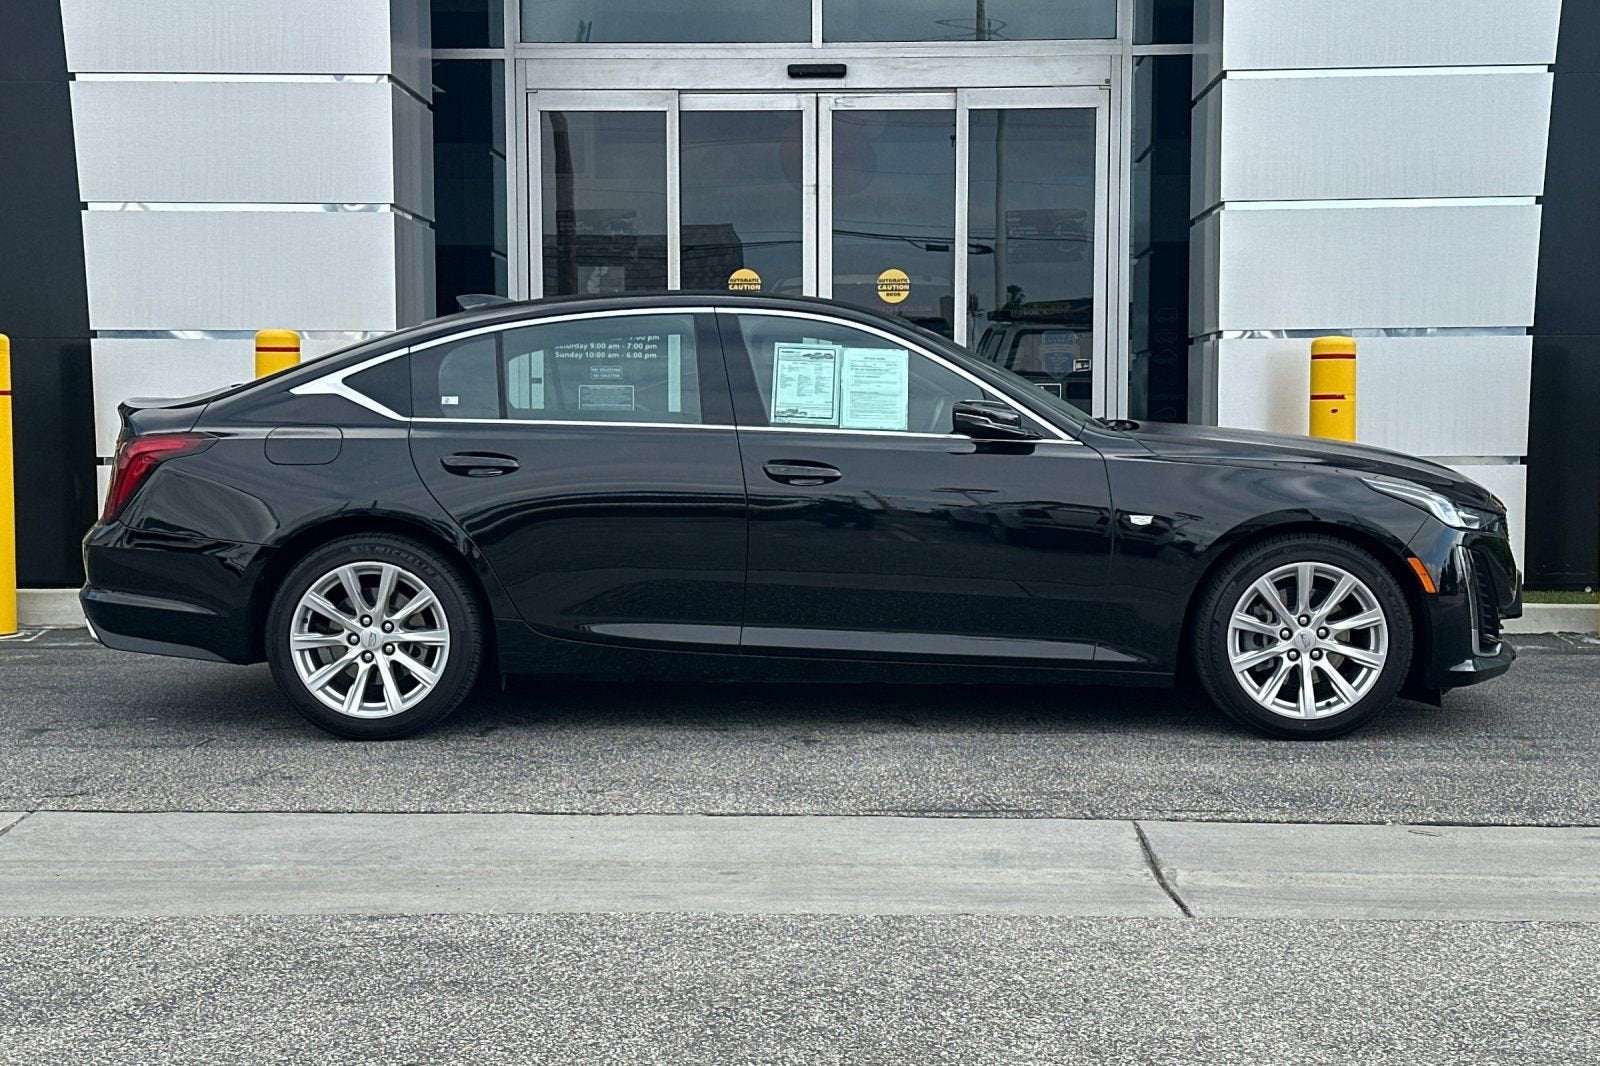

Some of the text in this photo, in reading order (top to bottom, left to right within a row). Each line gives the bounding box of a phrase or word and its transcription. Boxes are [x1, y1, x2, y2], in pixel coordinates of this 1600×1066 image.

[589, 342, 606, 350] 9:00
[627, 342, 644, 350] 7:00
[555, 351, 583, 359] Sunday
[585, 351, 606, 359] 10:00
[626, 351, 643, 359] 6:00
